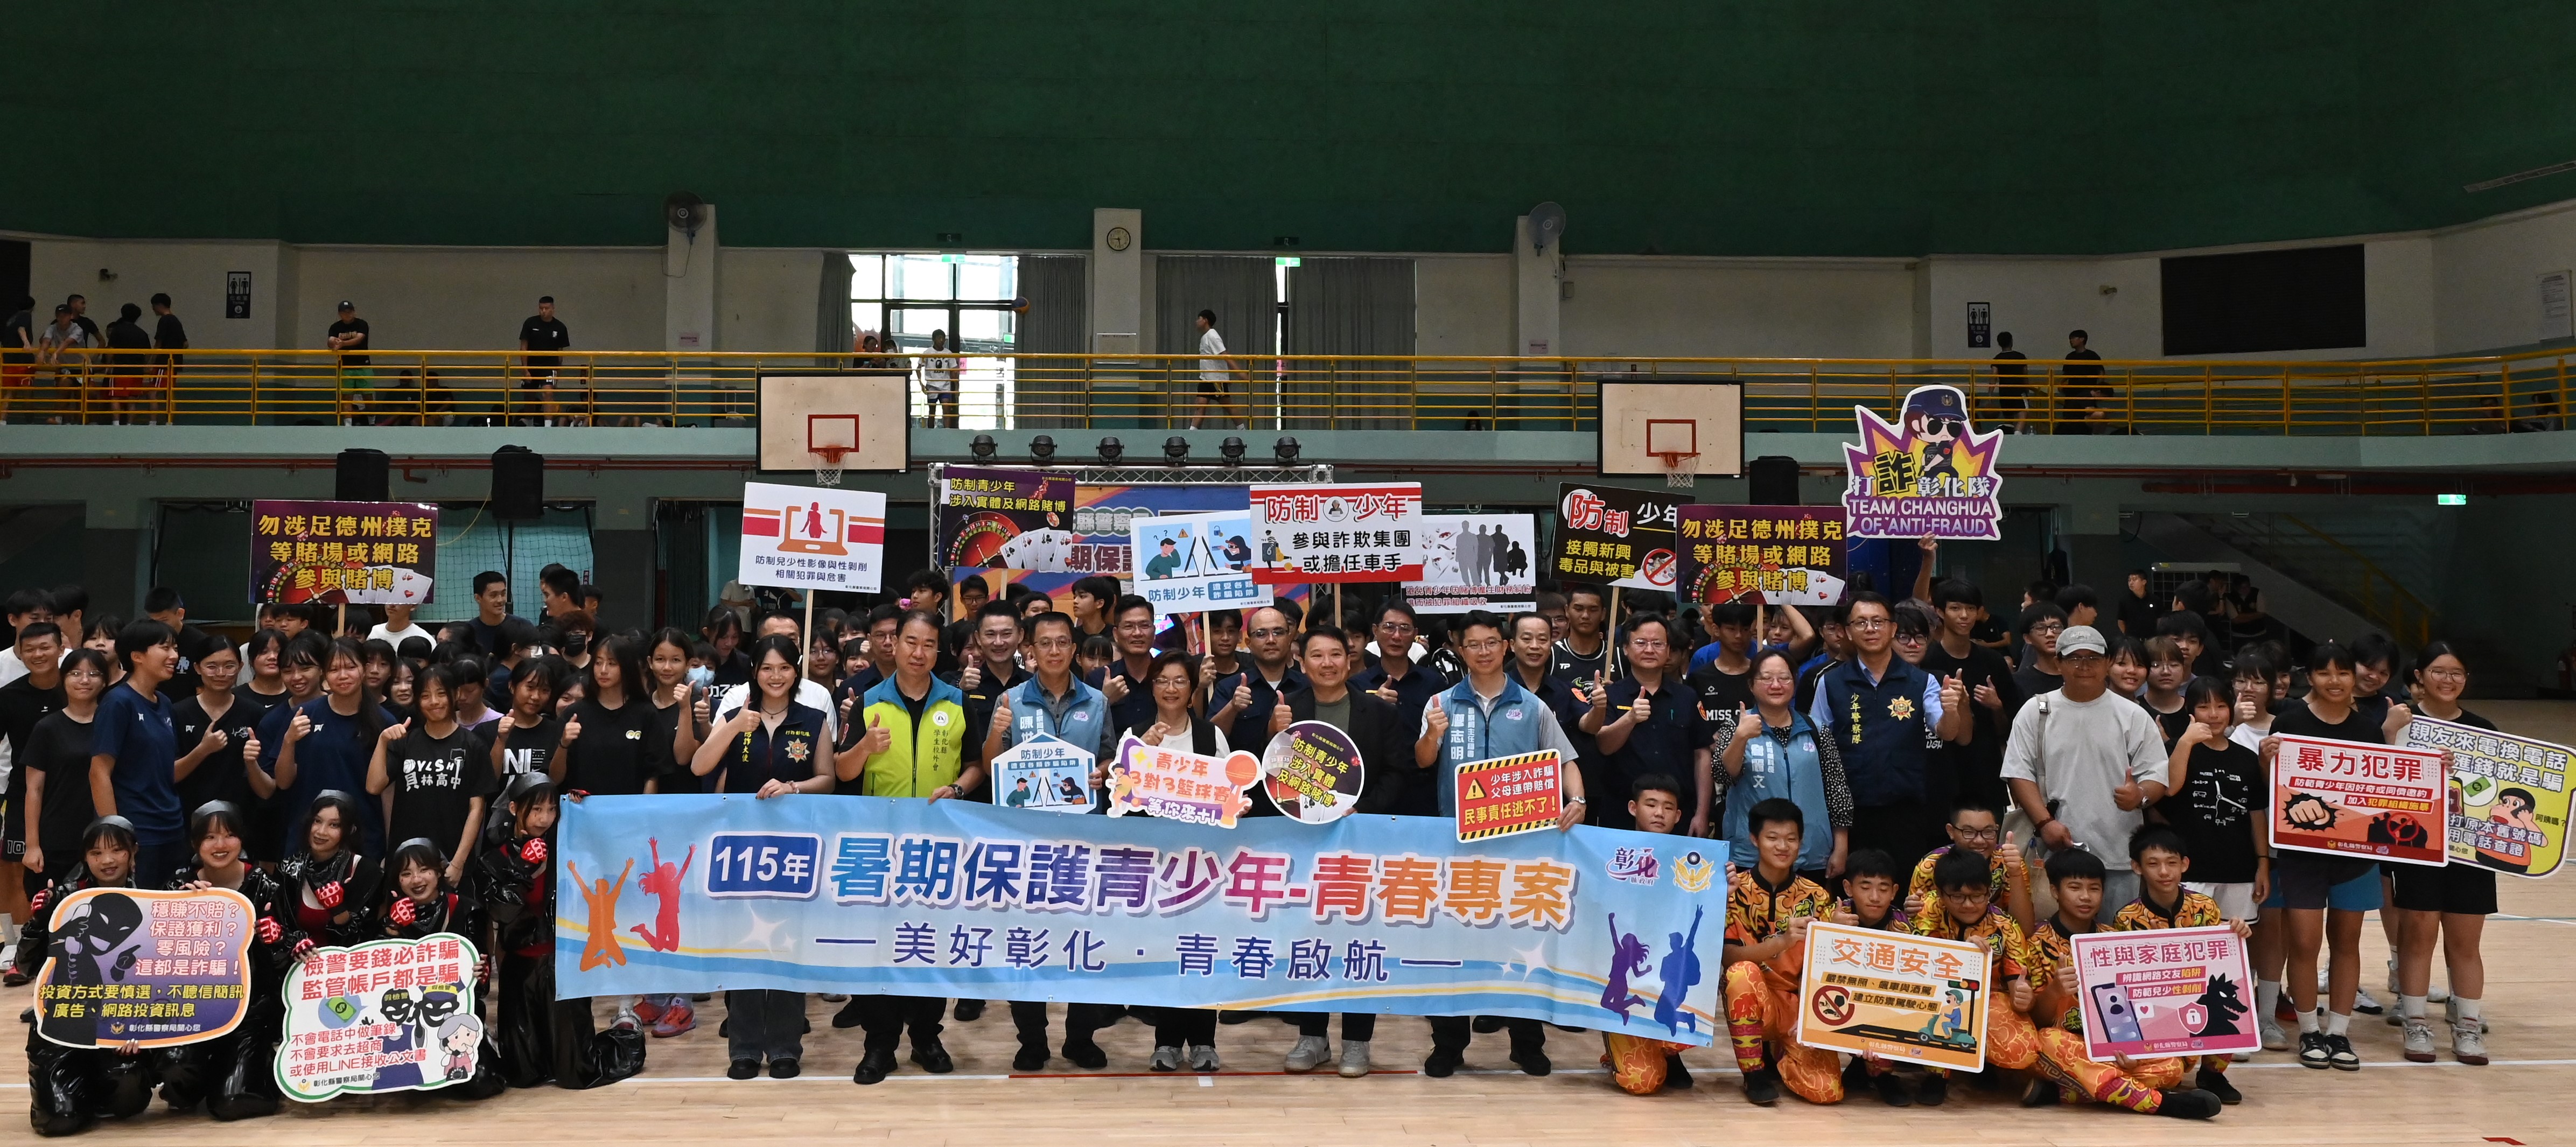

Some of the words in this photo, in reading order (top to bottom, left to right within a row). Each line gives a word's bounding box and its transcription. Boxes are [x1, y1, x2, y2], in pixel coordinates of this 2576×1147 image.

[1851, 450, 1991, 498] 打詐彰化隊
[950, 478, 1016, 493] 防制青少年
[949, 494, 1066, 512] 涉入實體及網路賭博
[1267, 496, 1319, 522] 防制
[1355, 494, 1408, 521] 少年
[1568, 493, 1629, 535] 防制
[1637, 502, 1677, 528] 少年
[1850, 499, 1895, 514] TEAM
[1901, 500, 1993, 515] CHANGHUA
[258, 515, 432, 537] 勿涉足德州撲克
[1682, 519, 1843, 540] 勿涉足德州撲克
[1861, 517, 1882, 532] OF
[1888, 517, 1986, 534] ANTI-FRAUD
[1292, 530, 1410, 549] 參與詐欺集團
[1566, 539, 1631, 561] 接觸新興
[270, 542, 419, 564] 等賭場或網路
[755, 555, 867, 571] 防制兒少性影像與性剝削
[1303, 553, 1402, 573] 或擔任車手
[1693, 544, 1831, 565] 等賭場或網路
[295, 569, 394, 589] 參與賭博
[775, 569, 846, 582] 相關犯罪與危害
[1559, 557, 1635, 579] 毒品與被害
[1716, 570, 1808, 591] 參與賭博
[1149, 586, 1205, 603] 防制少年
[1706, 709, 1732, 721] MISS
[1850, 693, 1862, 744] 少年警察隊
[1021, 748, 1065, 760] 防制少年
[1292, 738, 1349, 774] 防制青少年
[2410, 722, 2567, 772] 親友來電換電話
[1156, 752, 1209, 778] 青少年
[1289, 756, 1336, 788] 涉入實體
[2297, 746, 2423, 782] 暴力犯罪
[2407, 742, 2564, 793] 匯錢就是騙
[1491, 765, 1554, 786] 少年涉入詐騙
[1130, 771, 1230, 803] 3對3籃球賽
[1277, 770, 1335, 807] 及網路賭博
[1491, 778, 1555, 799] 父母連帶賠償
[2294, 779, 2426, 798] 防範青少年因好奇或同儕邀約
[1465, 796, 1556, 826] 民事責任逃不了！
[2347, 796, 2429, 810] 加入犯罪組織施暴
[2449, 814, 2543, 845] 打原本舊號碼
[2448, 829, 2524, 857] 用電話查證
[715, 846, 810, 883] 115年
[832, 835, 1569, 927] 暑期保護青少年-青春專案
[151, 900, 240, 918] 穩賺不賠？
[150, 921, 237, 938] 保證獲利？
[156, 940, 226, 956] 零風險？
[303, 940, 459, 977] 檢警要錢必詐騙
[2090, 939, 2229, 968] 性與家庭犯罪
[135, 959, 240, 976] 這都是詐騙！
[1831, 938, 1964, 981] 交通安全
[302, 963, 459, 1001] 監管帳戶都是騙
[2122, 968, 2201, 982] 辨識網路交友陷阱
[129, 1024, 201, 1032] 彰化縣警察局關心您
[291, 1024, 396, 1046] 不會電話中做筆錄
[291, 1039, 382, 1061] 不會要求去超商
[290, 1048, 426, 1076] 或使用LINE接收公文書
